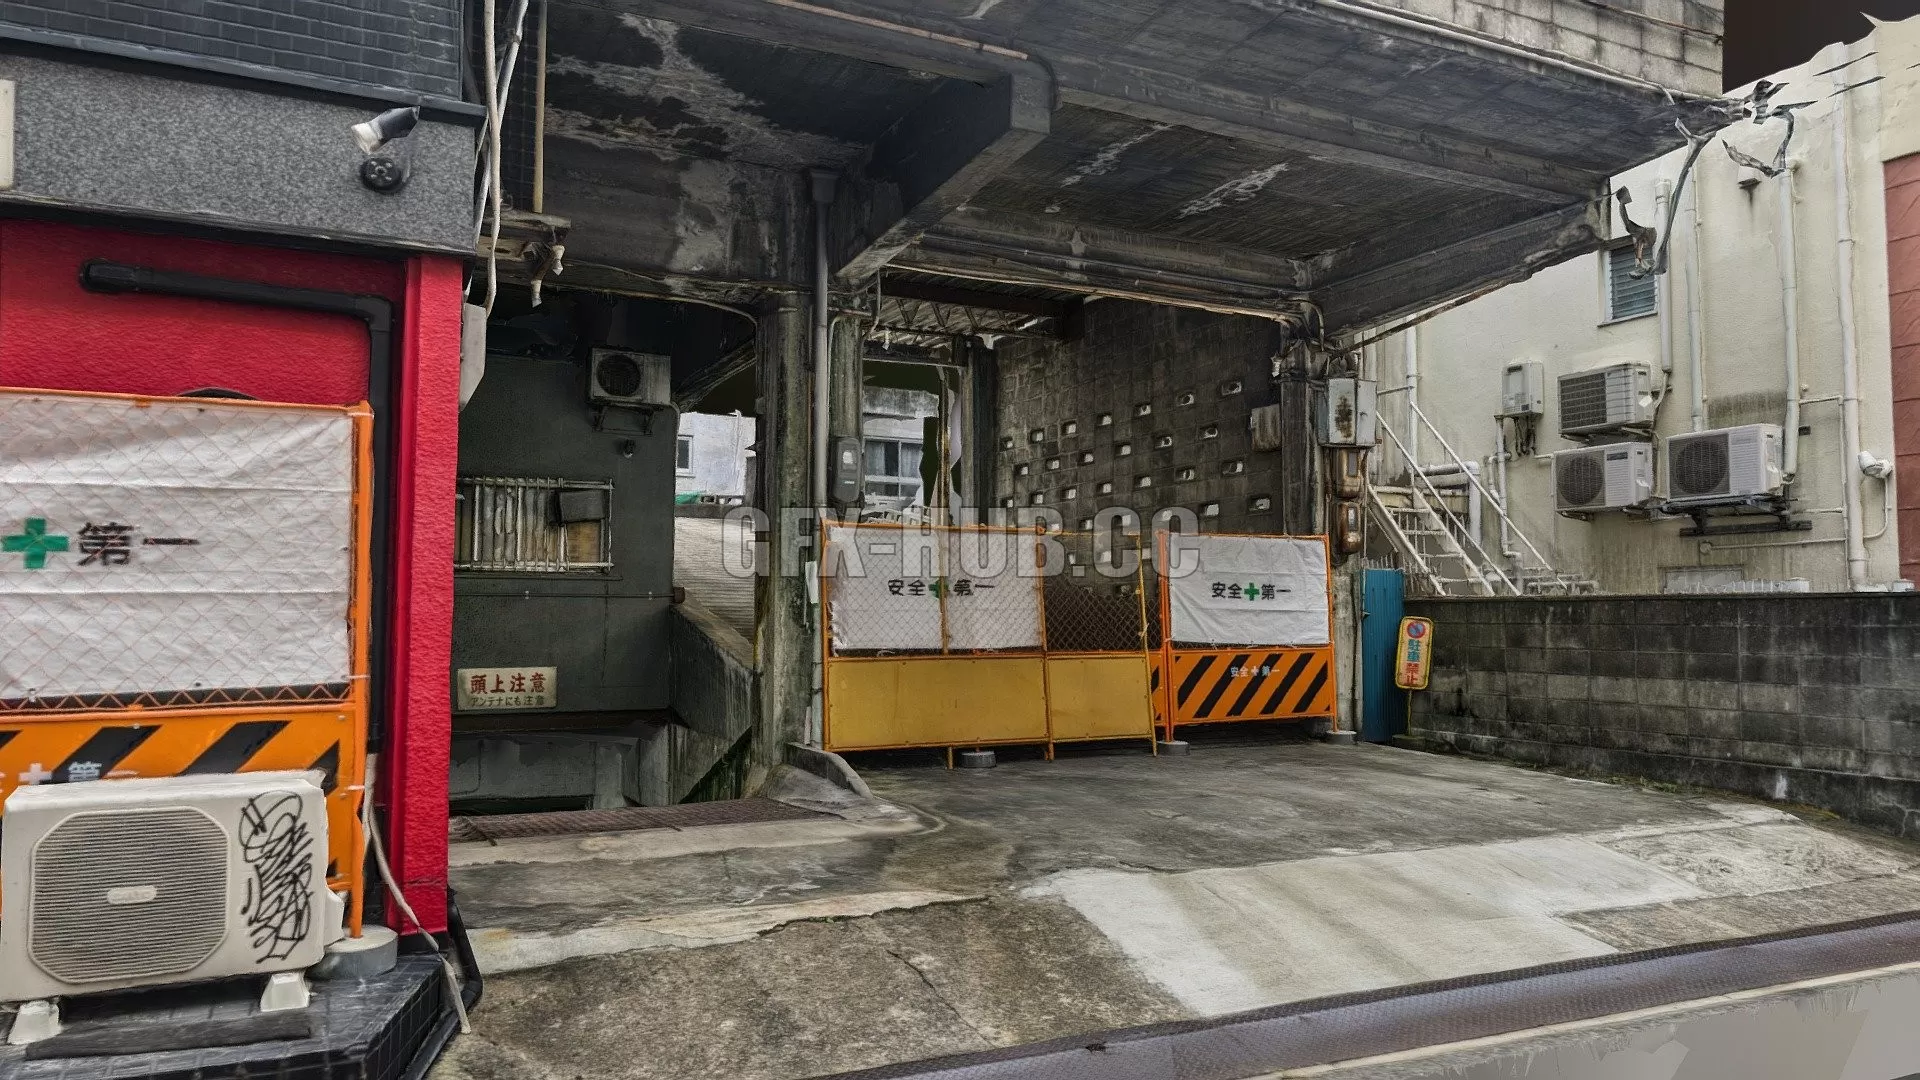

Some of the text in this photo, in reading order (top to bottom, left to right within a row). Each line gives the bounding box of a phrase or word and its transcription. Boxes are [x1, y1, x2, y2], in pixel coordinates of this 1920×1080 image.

[78, 522, 200, 566] 第一
[888, 579, 996, 596] 安全 第一
[1211, 582, 1292, 600] 安全 第一
[1230, 666, 1249, 678] 安全
[470, 672, 546, 694] 頭上注意
[470, 695, 545, 707] アンテナにも注意
